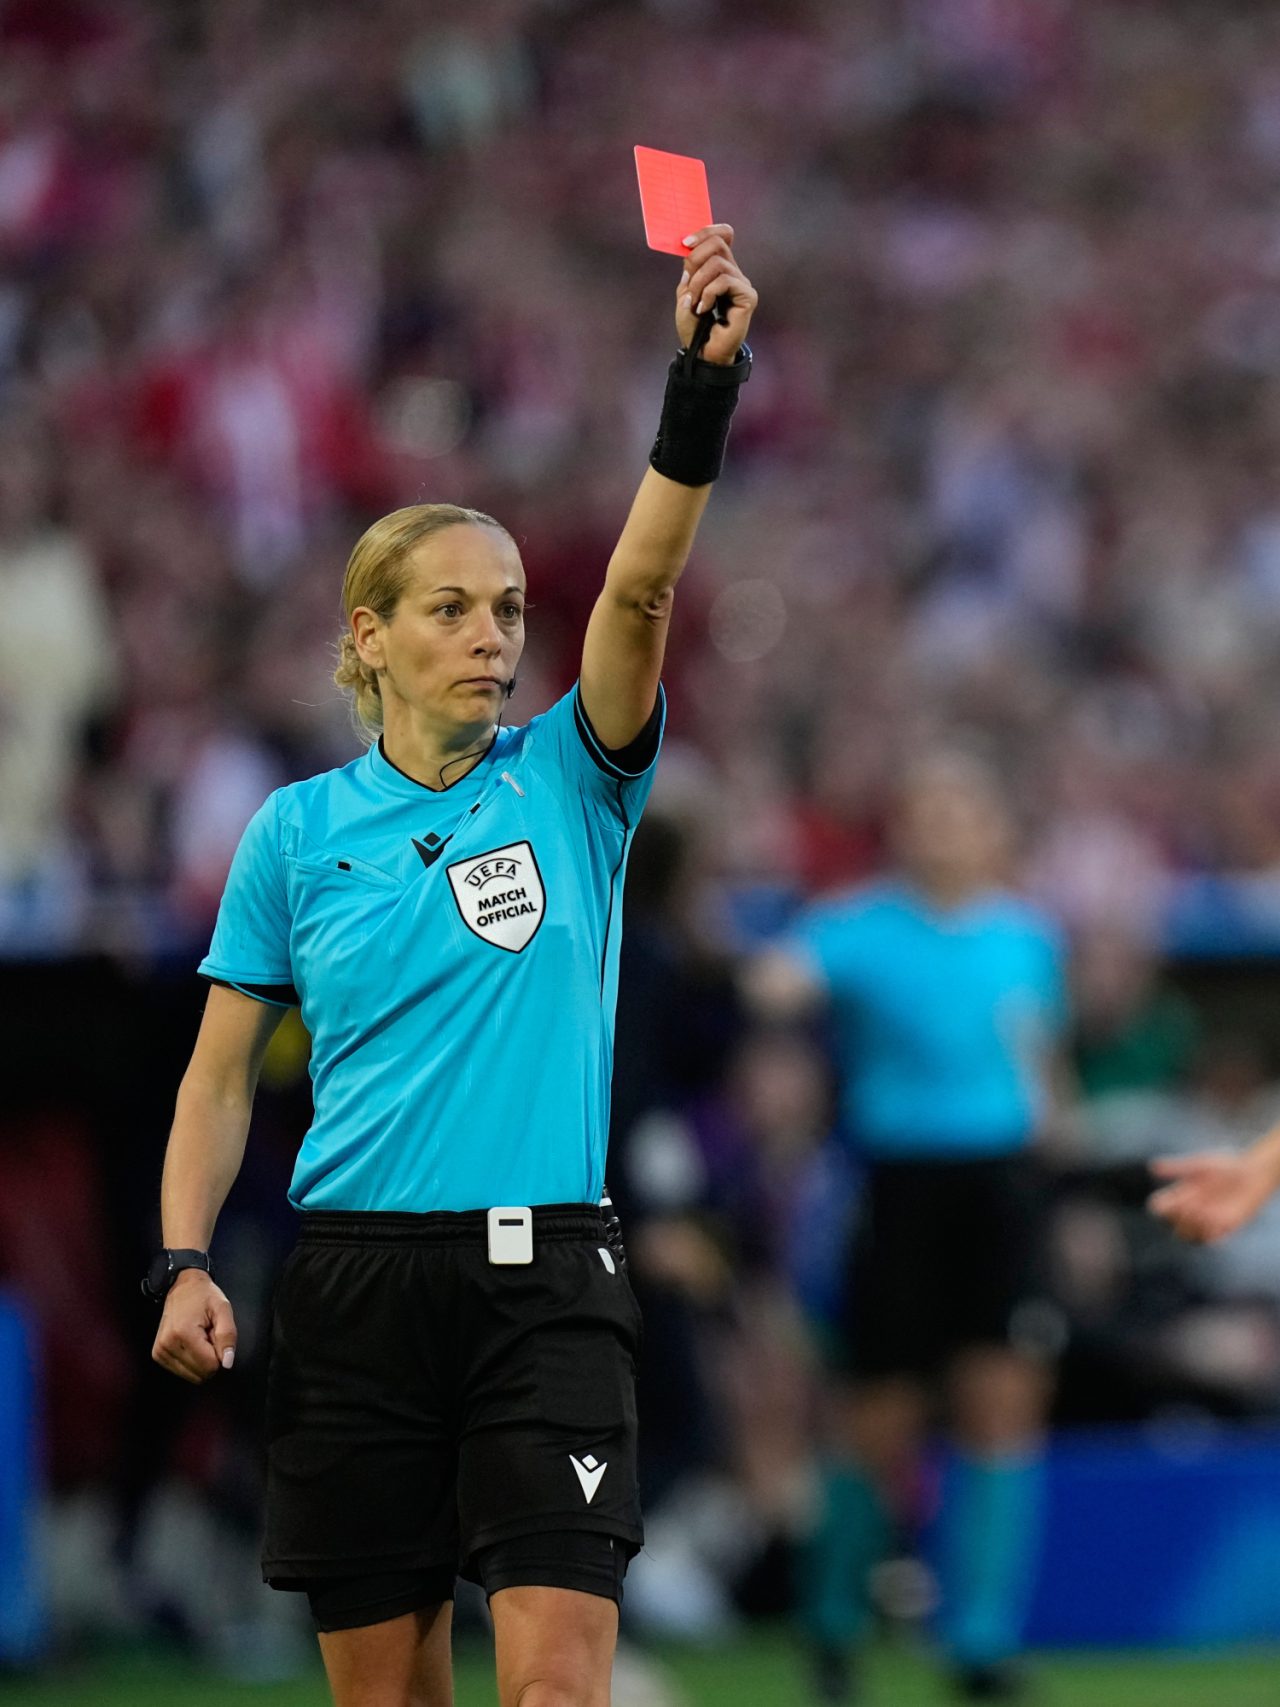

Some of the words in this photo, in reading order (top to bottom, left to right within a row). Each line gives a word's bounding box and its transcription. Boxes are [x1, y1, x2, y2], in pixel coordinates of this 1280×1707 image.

[468, 861, 516, 888] UEFA
[477, 887, 527, 911] MATCH
[476, 901, 538, 927] OFFICIAL
